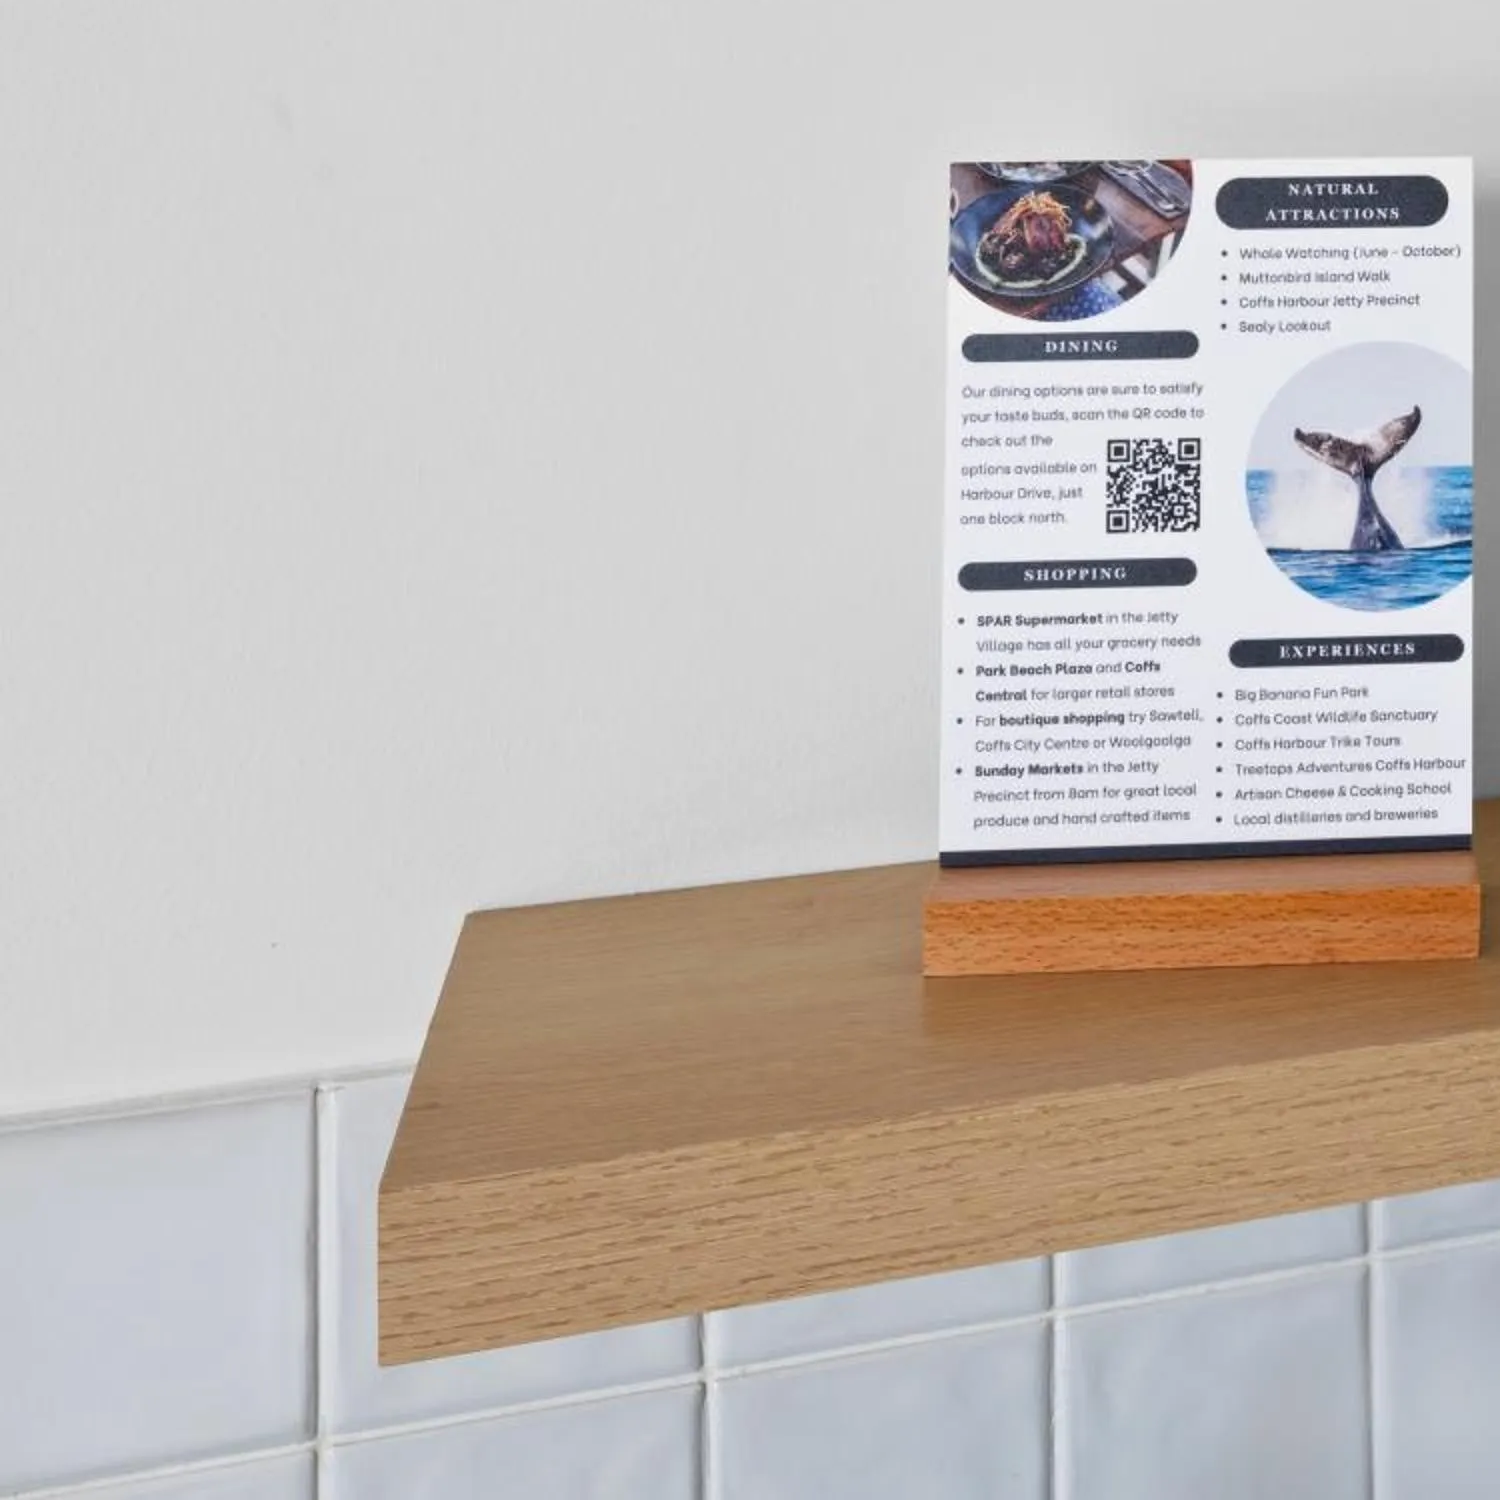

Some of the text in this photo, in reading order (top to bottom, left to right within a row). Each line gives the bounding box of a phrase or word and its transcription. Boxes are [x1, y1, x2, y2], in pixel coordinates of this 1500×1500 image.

[1288, 183, 1379, 197] NATURAL
[1266, 207, 1400, 222] ATTRACTIONS
[1284, 246, 1349, 261] Watching
[1403, 244, 1461, 258] October)
[1239, 270, 1390, 284] Muttonbird Island Walk
[1239, 294, 1420, 309] Coffs Harbour Jetty Precinct
[1279, 320, 1331, 332] Lookout
[1045, 340, 1119, 354] DINING
[962, 382, 1204, 399] Our dining options are sure to satisfy
[961, 407, 1204, 425] your taste buds, scan the QR code to
[961, 435, 1053, 447] check out the
[961, 462, 1097, 478] options available on
[961, 488, 1014, 500] Harbour
[1058, 487, 1083, 500] just
[960, 515, 985, 525] one
[989, 513, 1024, 524] block
[1023, 567, 1128, 582] SHOPPING
[977, 611, 1179, 628] SPAR Supermarket in the Jetty
[976, 635, 1201, 655] Village has all your grocery needs
[1280, 643, 1416, 660] EXPERIENCES
[976, 661, 1161, 677] Park Beach Plaza and Coffs
[976, 686, 1175, 702] Central for larger retail stores
[1235, 686, 1369, 703] Big Banana Fun Park
[976, 715, 996, 727] For
[999, 713, 1059, 728] boutique
[1063, 712, 1125, 727] shopping
[1129, 712, 1146, 724] try
[1235, 709, 1438, 726] Coffs Coast Wildlife Sanctuary
[976, 739, 1011, 752] Coffs
[1014, 739, 1041, 753] City
[1044, 738, 1089, 750] Centre
[1093, 739, 1106, 748] or
[1235, 736, 1400, 751] Coffs Harbour Trike Tours
[975, 760, 1159, 779] Sunday Markets in the Jetty
[1235, 758, 1466, 777] Treetops Adventures Coffs Harbour
[974, 784, 1197, 803] Precinct from 8am for great local
[1235, 782, 1452, 801] Artisan Cheese & Cooking School
[974, 810, 1191, 830] produce and hand crafted items
[1234, 809, 1438, 826] Local distilleries and breweries
